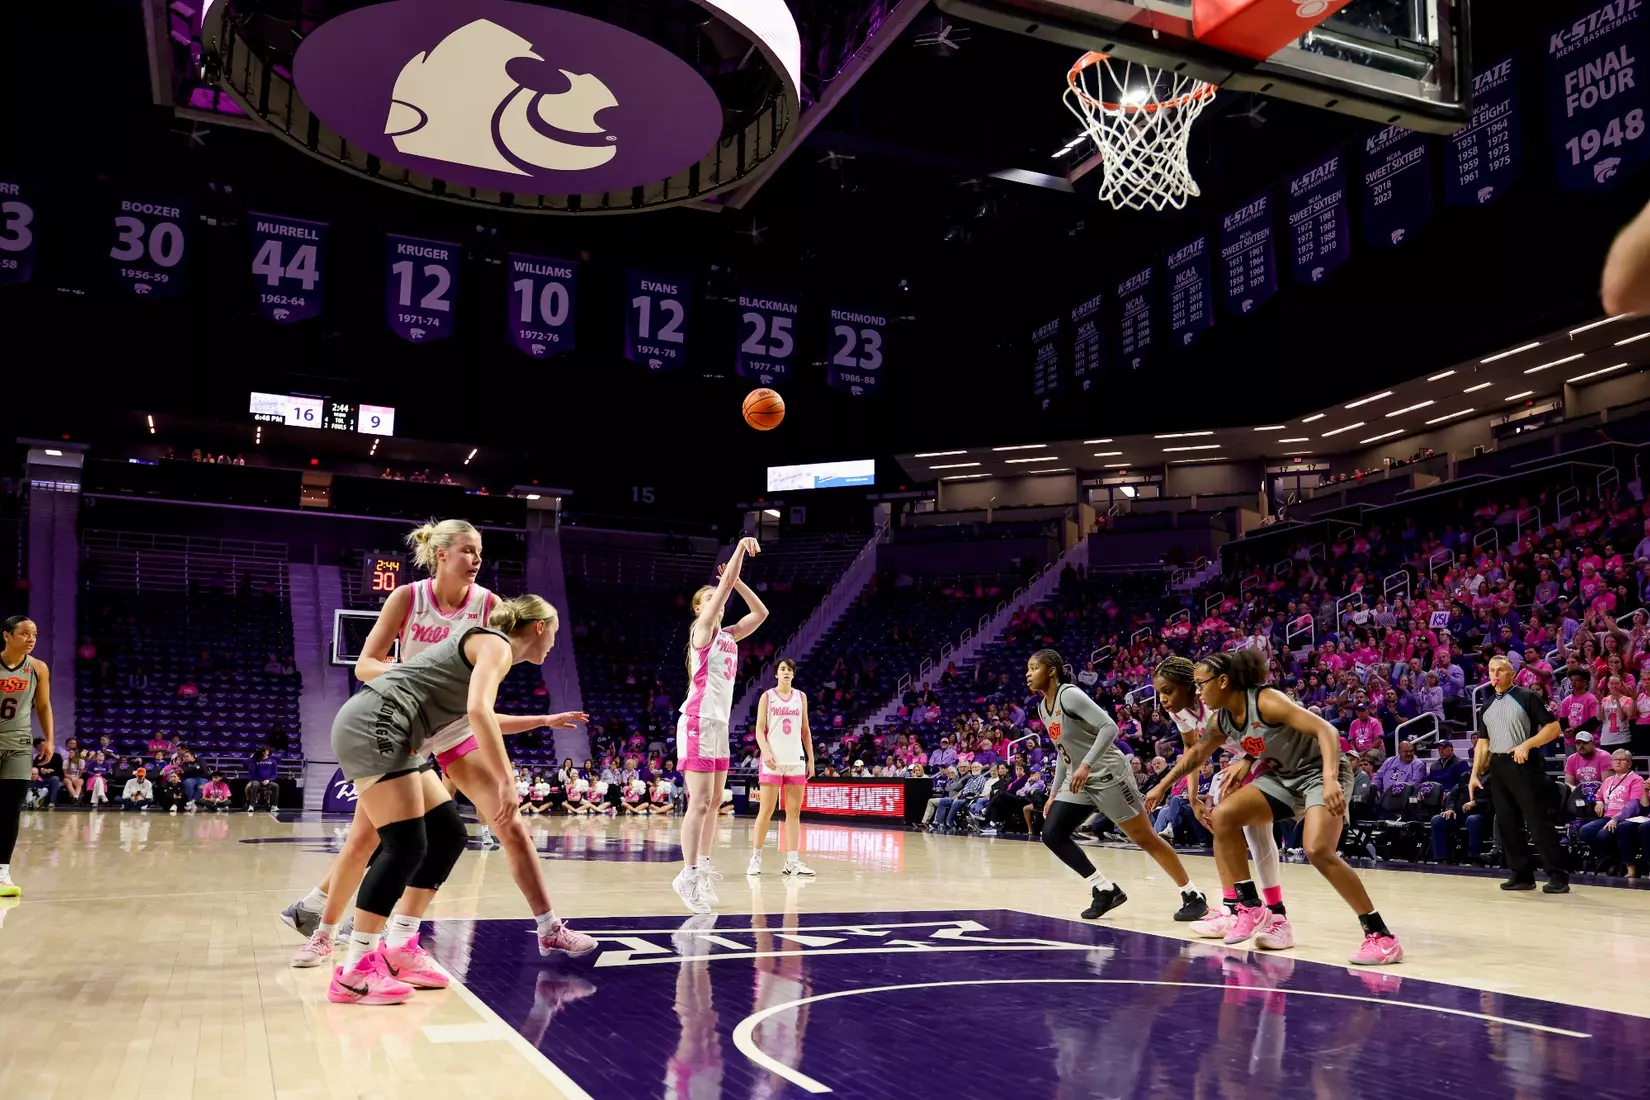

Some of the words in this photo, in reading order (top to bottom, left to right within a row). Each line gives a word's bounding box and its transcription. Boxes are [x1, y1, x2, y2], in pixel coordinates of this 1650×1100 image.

[1549, 0, 1643, 54] K-STATE
[1556, 41, 1581, 59] MEN'S
[1583, 11, 1638, 44] BASKETBALL
[1472, 58, 1512, 91] TATE
[1565, 44, 1635, 95] FINAL
[1566, 67, 1635, 118] FOUR
[1480, 100, 1510, 125] EIGHT
[1457, 134, 1477, 151] 1951
[1486, 118, 1508, 136] 1964
[1565, 108, 1645, 166] 1948
[1386, 150, 1402, 163] NCAA
[1458, 146, 1478, 163] 1958
[1487, 131, 1509, 148] 1972
[1365, 162, 1391, 185] SWEET
[1391, 145, 1425, 171] SIXTEEN
[1459, 158, 1479, 175] 1959
[1488, 143, 1510, 160] 1973
[1460, 170, 1479, 186] 1961
[1489, 155, 1511, 172] 1975
[1291, 156, 1339, 194] K-STATE
[1373, 179, 1392, 196] 2018
[1374, 191, 1392, 207] 2023
[121, 200, 181, 218] BOOZER
[1224, 196, 1267, 229] K-STATE
[1289, 206, 1313, 225] SWEET
[1313, 190, 1342, 213] SIXTEEN
[256, 221, 319, 240] MURRELL
[1297, 221, 1313, 234] 1972
[1319, 209, 1335, 223] 1981
[1297, 231, 1313, 245] 1973
[1320, 220, 1336, 234] 1982
[109, 216, 184, 267] 30
[397, 244, 448, 260] KRUGER
[1168, 237, 1204, 267] K-STATE
[1221, 241, 1243, 258] SWEET
[1244, 227, 1270, 248] SIXTEEN
[1298, 241, 1314, 255] 1975
[1298, 252, 1314, 265] 1977
[1320, 241, 1337, 255] 2010
[120, 268, 169, 283] 1956-59
[252, 239, 319, 291] 44
[514, 261, 572, 278] WILLIAMS
[1176, 266, 1196, 284] NCAA
[392, 260, 450, 312] 12
[641, 280, 678, 294] EVANS
[1118, 267, 1152, 295] K-STATE
[260, 294, 305, 306] 1962-64
[514, 278, 569, 326] 10
[739, 296, 798, 313] BLACKMAN
[1072, 294, 1101, 319] K-STATE
[1126, 294, 1144, 311] NCAA
[398, 313, 440, 327] 1971-74
[632, 295, 684, 343] 12
[831, 309, 886, 326] RICHMOND
[520, 329, 559, 342] 1972-76
[741, 312, 794, 358] 25
[833, 325, 883, 370] 23
[840, 372, 875, 384] 1986-88
[254, 414, 270, 422] 6:48
[271, 415, 283, 423] PM
[294, 407, 314, 421] 16
[332, 403, 349, 413] 2:44
[331, 423, 347, 431] FOULS
[371, 416, 381, 428] 9
[631, 486, 656, 504] 15
[376, 560, 400, 572] 2:44
[373, 572, 395, 591] 30
[1432, 613, 1450, 626] KSU
[1, 698, 18, 720] 6
[771, 707, 800, 717] Wildcats
[782, 718, 792, 735] 6
[806, 786, 849, 809] RAISING
[852, 787, 900, 811] CANE'S
